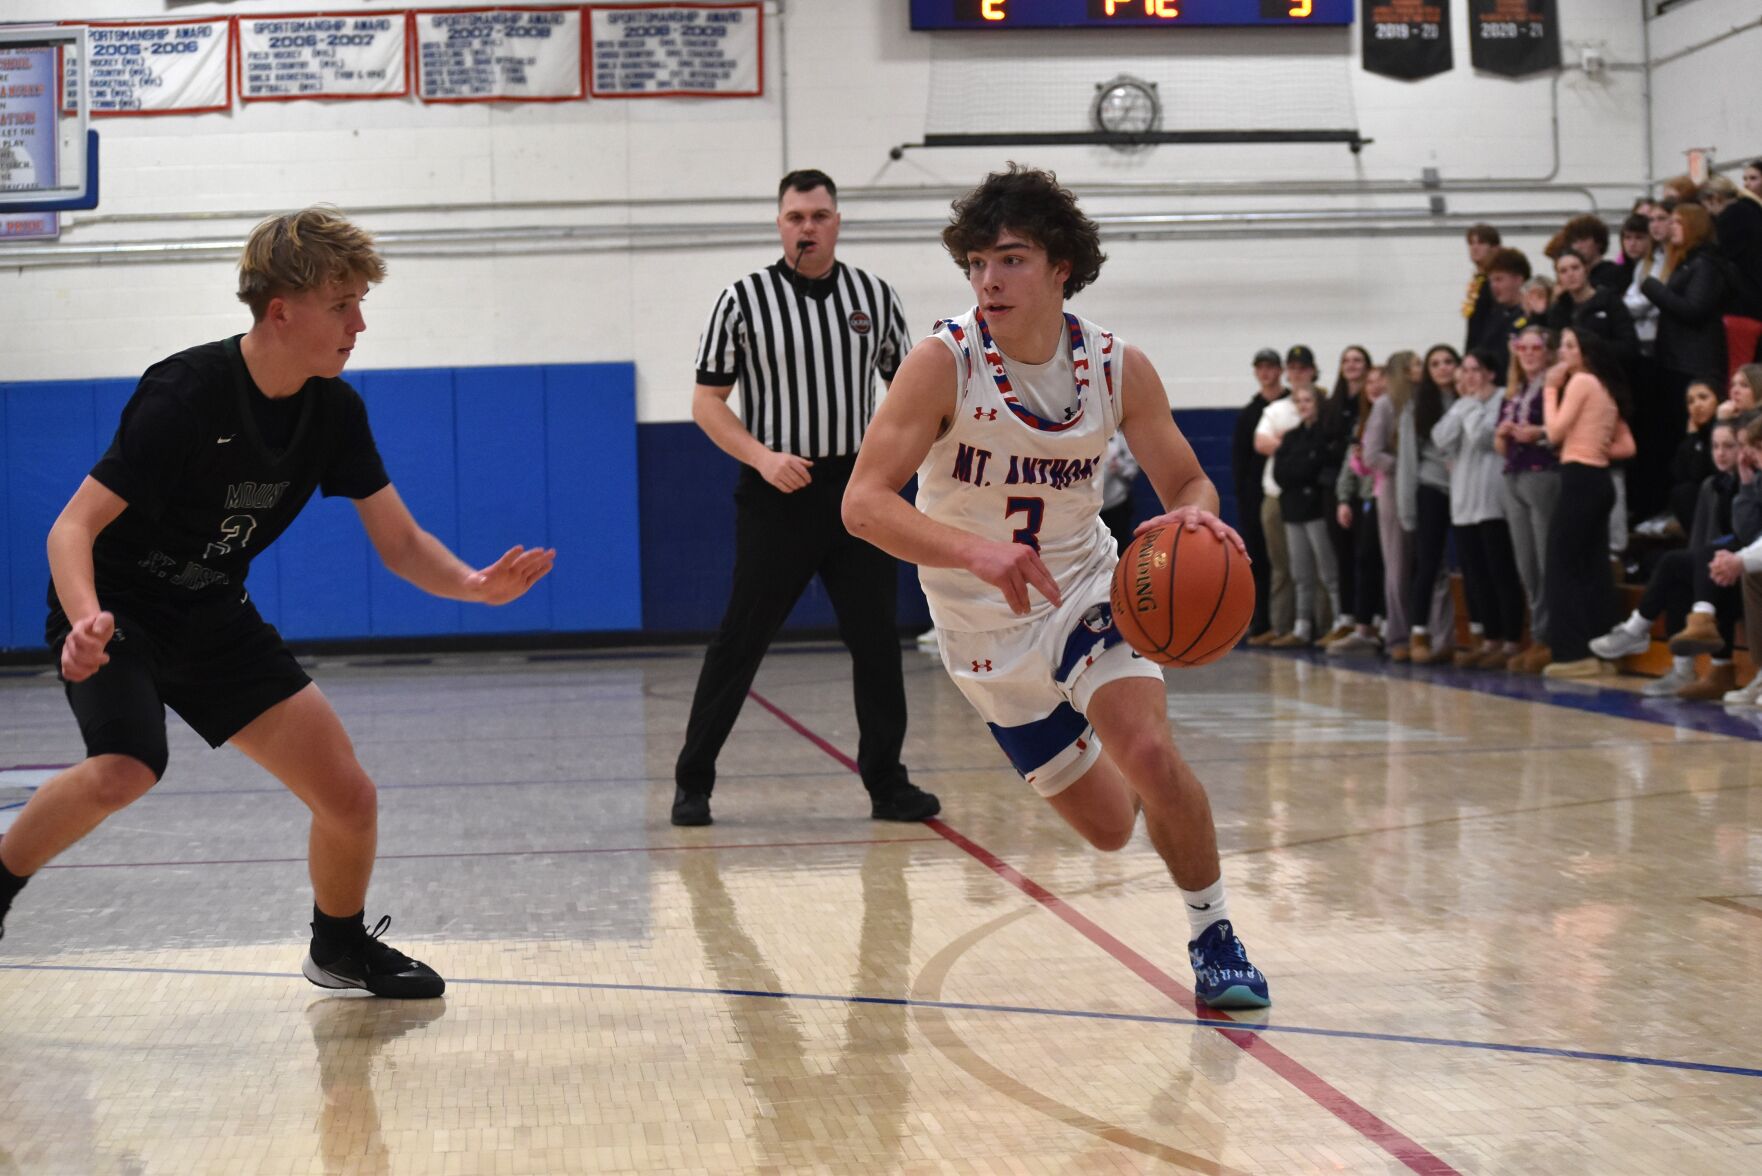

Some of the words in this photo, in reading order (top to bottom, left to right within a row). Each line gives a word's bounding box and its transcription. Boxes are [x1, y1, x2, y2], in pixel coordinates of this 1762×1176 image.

[88, 28, 170, 42] PORTSMANSHIP
[175, 25, 212, 38] AWARD
[254, 20, 346, 34] SPORTSMANSHIP
[353, 19, 391, 32] AWARD
[952, 442, 992, 487] MT.
[1005, 496, 1045, 558] 3
